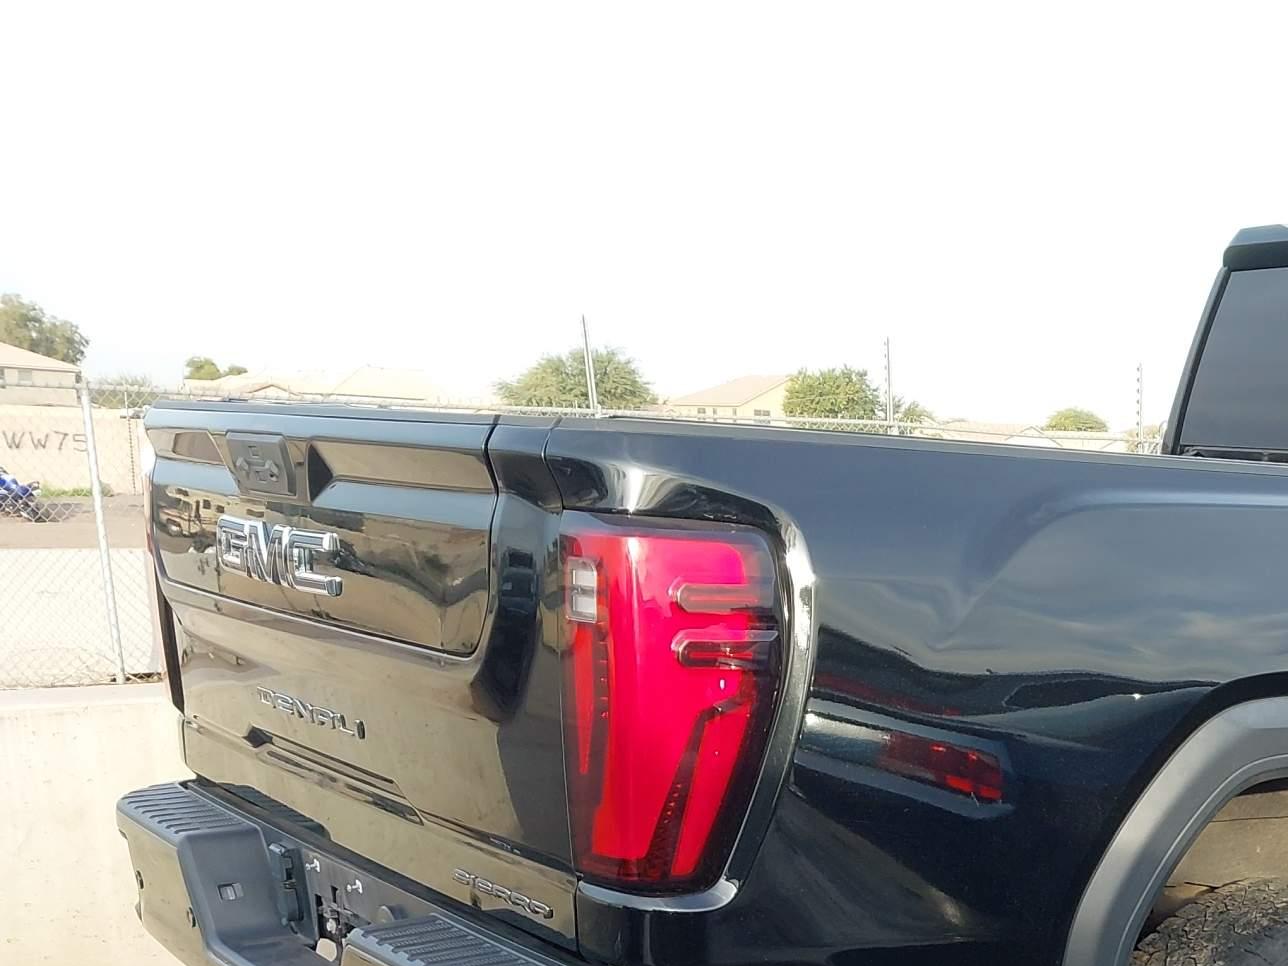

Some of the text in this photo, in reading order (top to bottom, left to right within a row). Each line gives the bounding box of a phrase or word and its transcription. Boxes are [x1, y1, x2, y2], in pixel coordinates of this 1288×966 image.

[2, 430, 88, 452] WW75
[216, 514, 343, 597] GMC
[257, 686, 366, 740] DENALI
[452, 868, 554, 919] SIERRA
